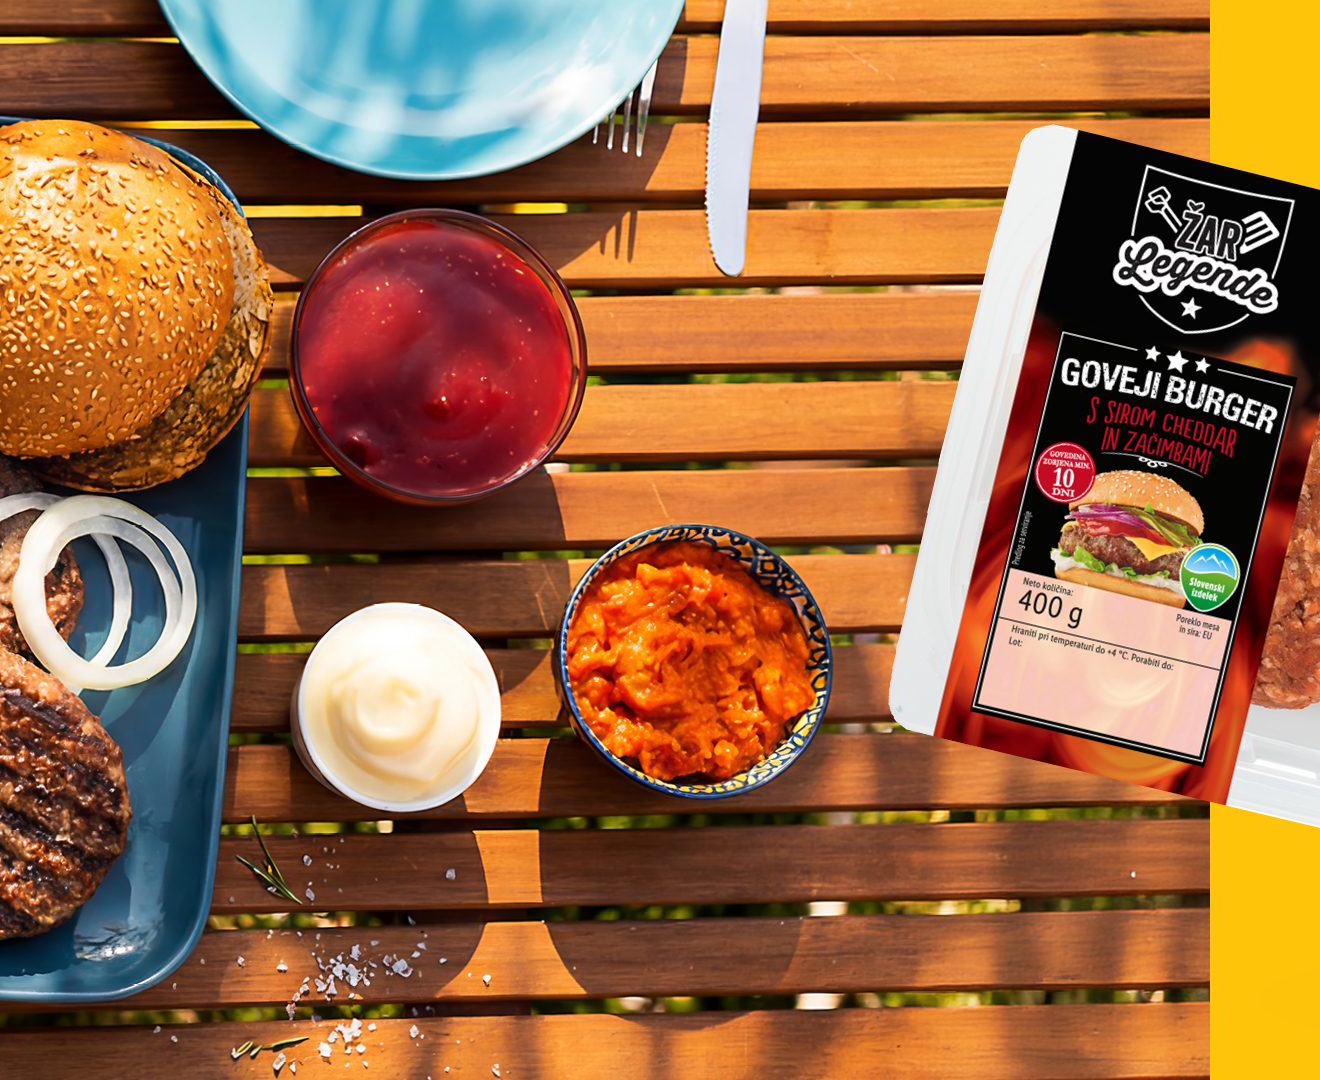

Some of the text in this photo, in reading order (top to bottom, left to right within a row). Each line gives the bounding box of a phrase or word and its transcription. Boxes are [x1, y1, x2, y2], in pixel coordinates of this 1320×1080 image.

[1175, 199, 1242, 262] ŽAR
[1113, 236, 1279, 315] Legende
[1061, 358, 1278, 434] GOVEJI BURGER
[1104, 400, 1157, 428] SIROM
[1162, 413, 1238, 458] CHEDDAR
[1049, 450, 1086, 461] GOVEDINA
[1101, 426, 1212, 476] IN ZAČIMBAMI
[1074, 461, 1091, 470] MIN.
[1053, 467, 1075, 488] 10
[1051, 487, 1075, 498] DNI
[1022, 577, 1074, 597] Neto količina:
[1189, 577, 1226, 593] Slovenski
[1191, 588, 1218, 602] izdelek
[1018, 590, 1083, 629] 400 g
[1176, 613, 1220, 632] Poreklo mesa
[1179, 625, 1213, 640] in sira: EU
[1008, 637, 1023, 647] Lot:
[1011, 625, 1038, 637] Hraniti
[1038, 631, 1049, 641] pri
[1050, 635, 1095, 652] temperaturi
[1095, 645, 1105, 654] do
[1131, 653, 1160, 668] Porabiti
[1161, 661, 1174, 671] do:
